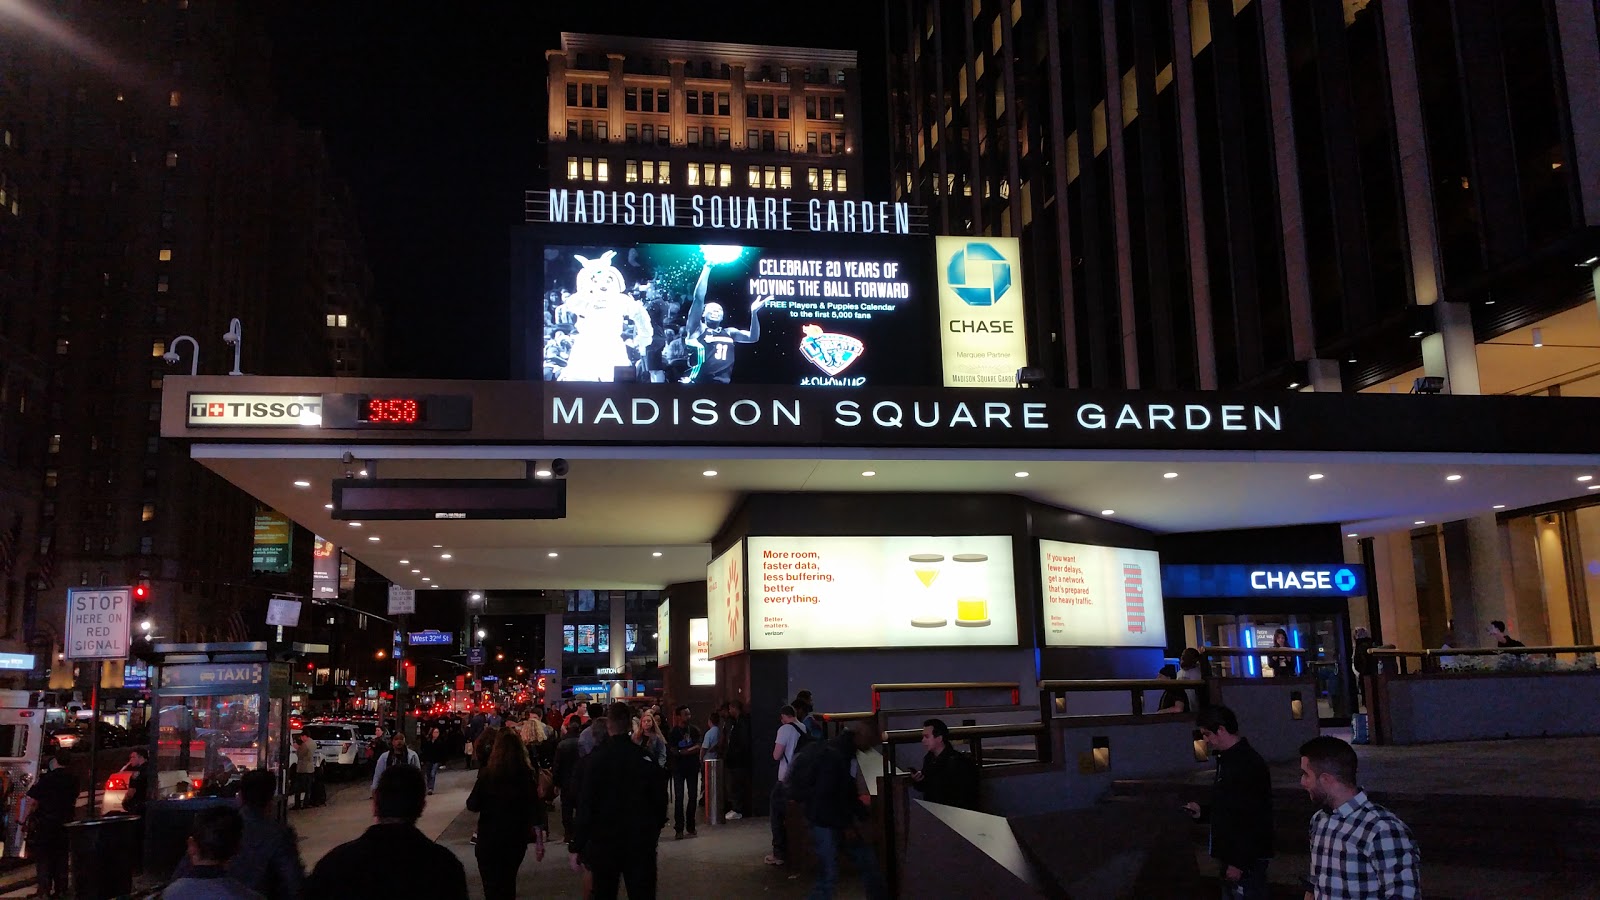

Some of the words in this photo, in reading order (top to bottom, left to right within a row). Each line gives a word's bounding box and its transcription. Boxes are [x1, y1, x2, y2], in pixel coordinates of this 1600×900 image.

[550, 188, 676, 226] MADISON
[692, 195, 793, 230] SQUARE
[809, 199, 909, 234] GARDEN
[759, 259, 822, 276] CELEBRATE
[826, 261, 841, 278] 20
[844, 262, 880, 278] YEARS
[884, 262, 898, 278] OF
[750, 278, 794, 296] MOVING
[798, 280, 820, 296] THE
[824, 281, 851, 298] BALL
[854, 282, 908, 298] FORWARD
[788, 302, 818, 310] Players
[827, 302, 858, 311] Puppies
[860, 302, 896, 311] Calendar
[950, 320, 1014, 333] CHASE
[714, 344, 728, 360] 31
[952, 374, 976, 382] MADISON
[977, 374, 996, 382] SQUARE
[369, 400, 417, 422] 9:58
[552, 398, 800, 426] MADISON
[835, 400, 1048, 428] SQUARE
[1076, 403, 1282, 430] GARDEN
[764, 550, 788, 558] More
[794, 562, 820, 570] data,
[1048, 564, 1062, 572] fewer
[764, 572, 784, 580] less
[786, 572, 834, 582] buffering,
[1048, 575, 1058, 583] get
[1250, 571, 1332, 589] CHASE
[764, 584, 794, 592] better
[1049, 585, 1064, 593] that's
[1065, 587, 1089, 595] prepared
[76, 596, 123, 611] STOP
[764, 595, 820, 604] everything.
[1058, 596, 1074, 605] heavy
[76, 614, 103, 624] HERE
[108, 613, 122, 623] ON
[86, 627, 110, 637] RED
[75, 640, 120, 650] SIGNAL
[218, 668, 249, 680] TAXI
